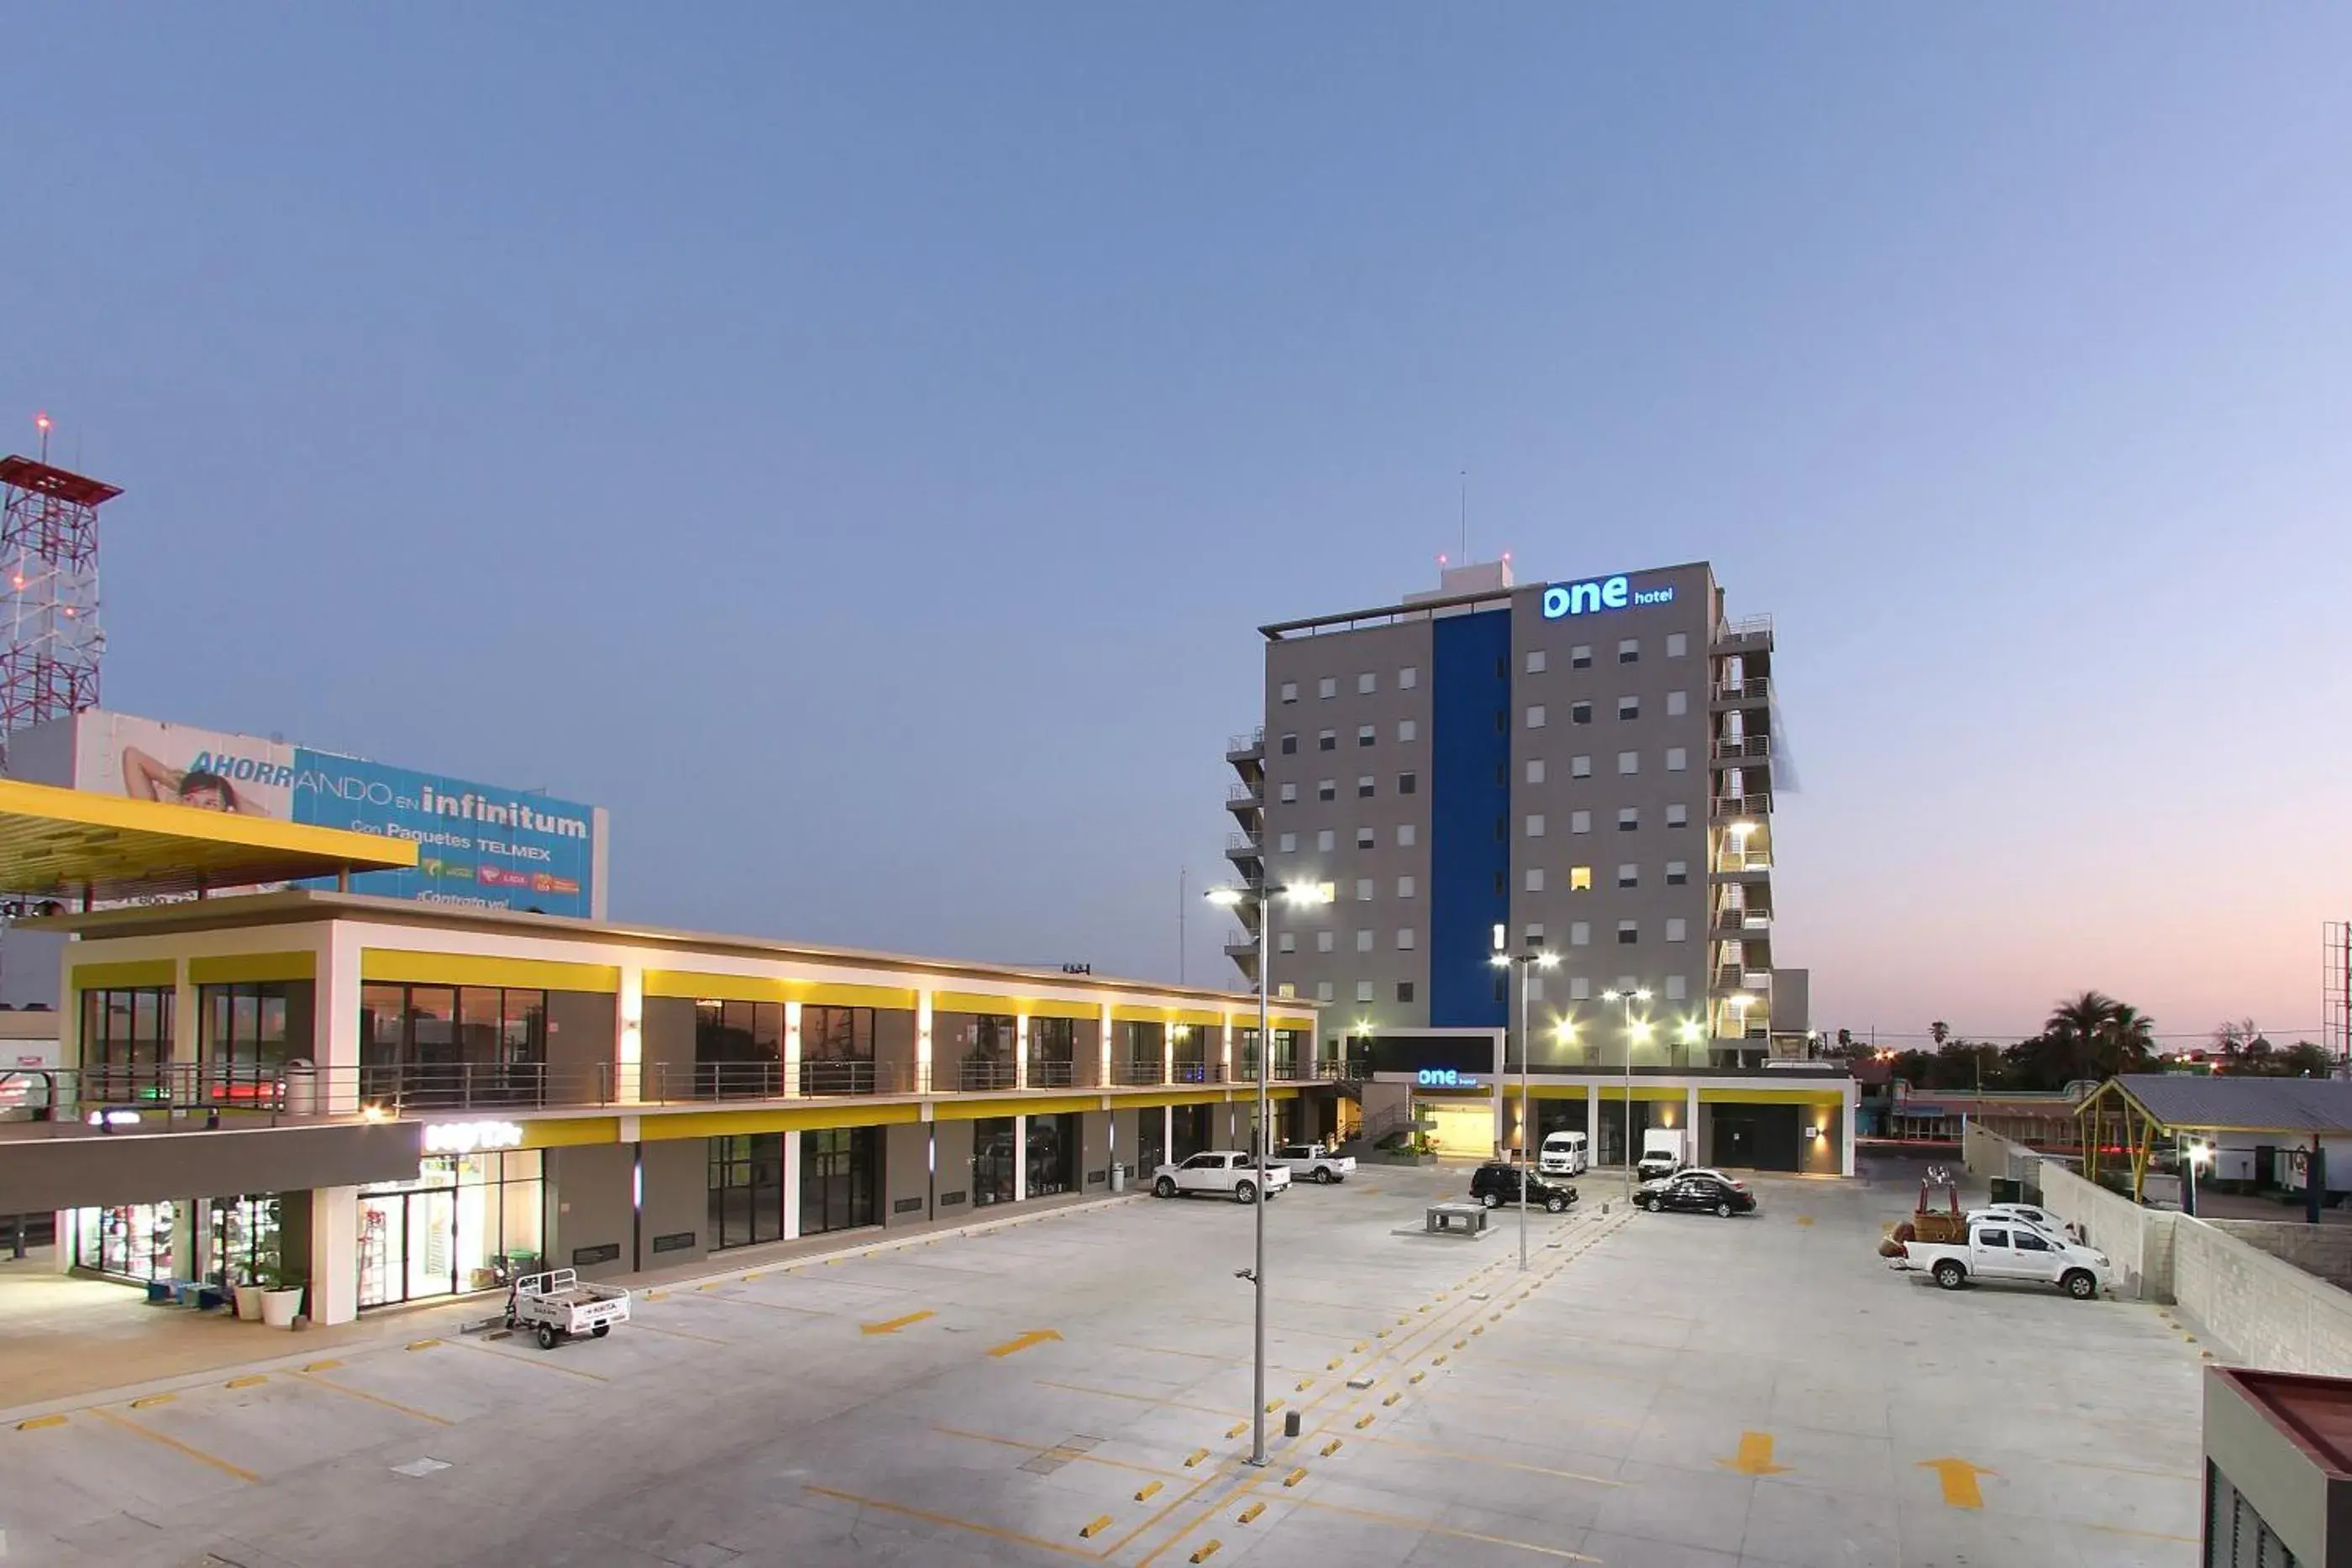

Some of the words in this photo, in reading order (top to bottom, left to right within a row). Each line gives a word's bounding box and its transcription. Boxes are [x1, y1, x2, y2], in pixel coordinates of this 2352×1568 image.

[1543, 576, 1628, 618] one
[1635, 587, 1672, 605] hotel
[396, 796, 418, 810] EN
[423, 785, 587, 839] infinitum
[351, 820, 382, 835] Con
[387, 823, 471, 849] Paquetes
[476, 838, 551, 862] TELMEX
[1418, 1069, 1457, 1085] one
